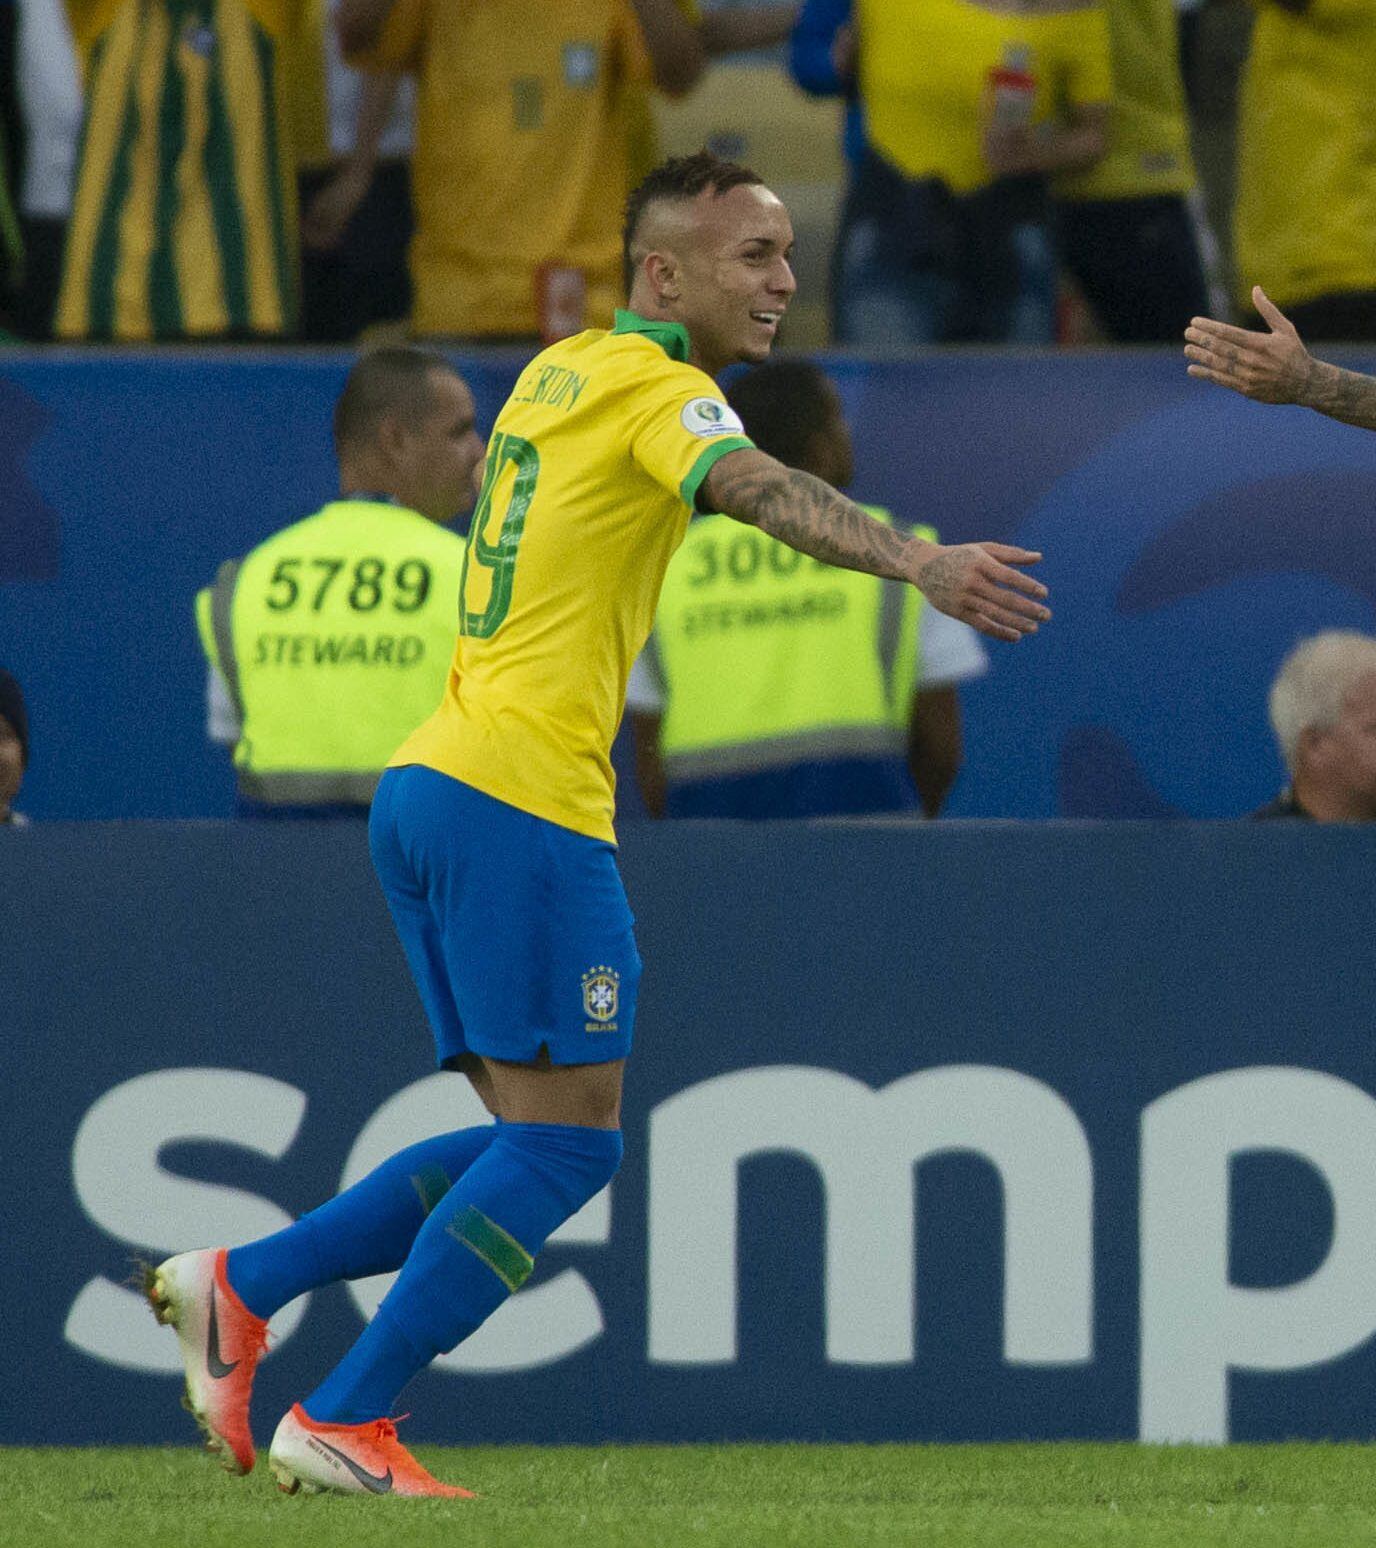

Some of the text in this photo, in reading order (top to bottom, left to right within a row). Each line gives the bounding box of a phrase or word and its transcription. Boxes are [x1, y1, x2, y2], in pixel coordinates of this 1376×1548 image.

[458, 432, 540, 640] 19
[686, 532, 843, 587] 300
[265, 556, 434, 613] 5789
[255, 632, 427, 669] STEWARD
